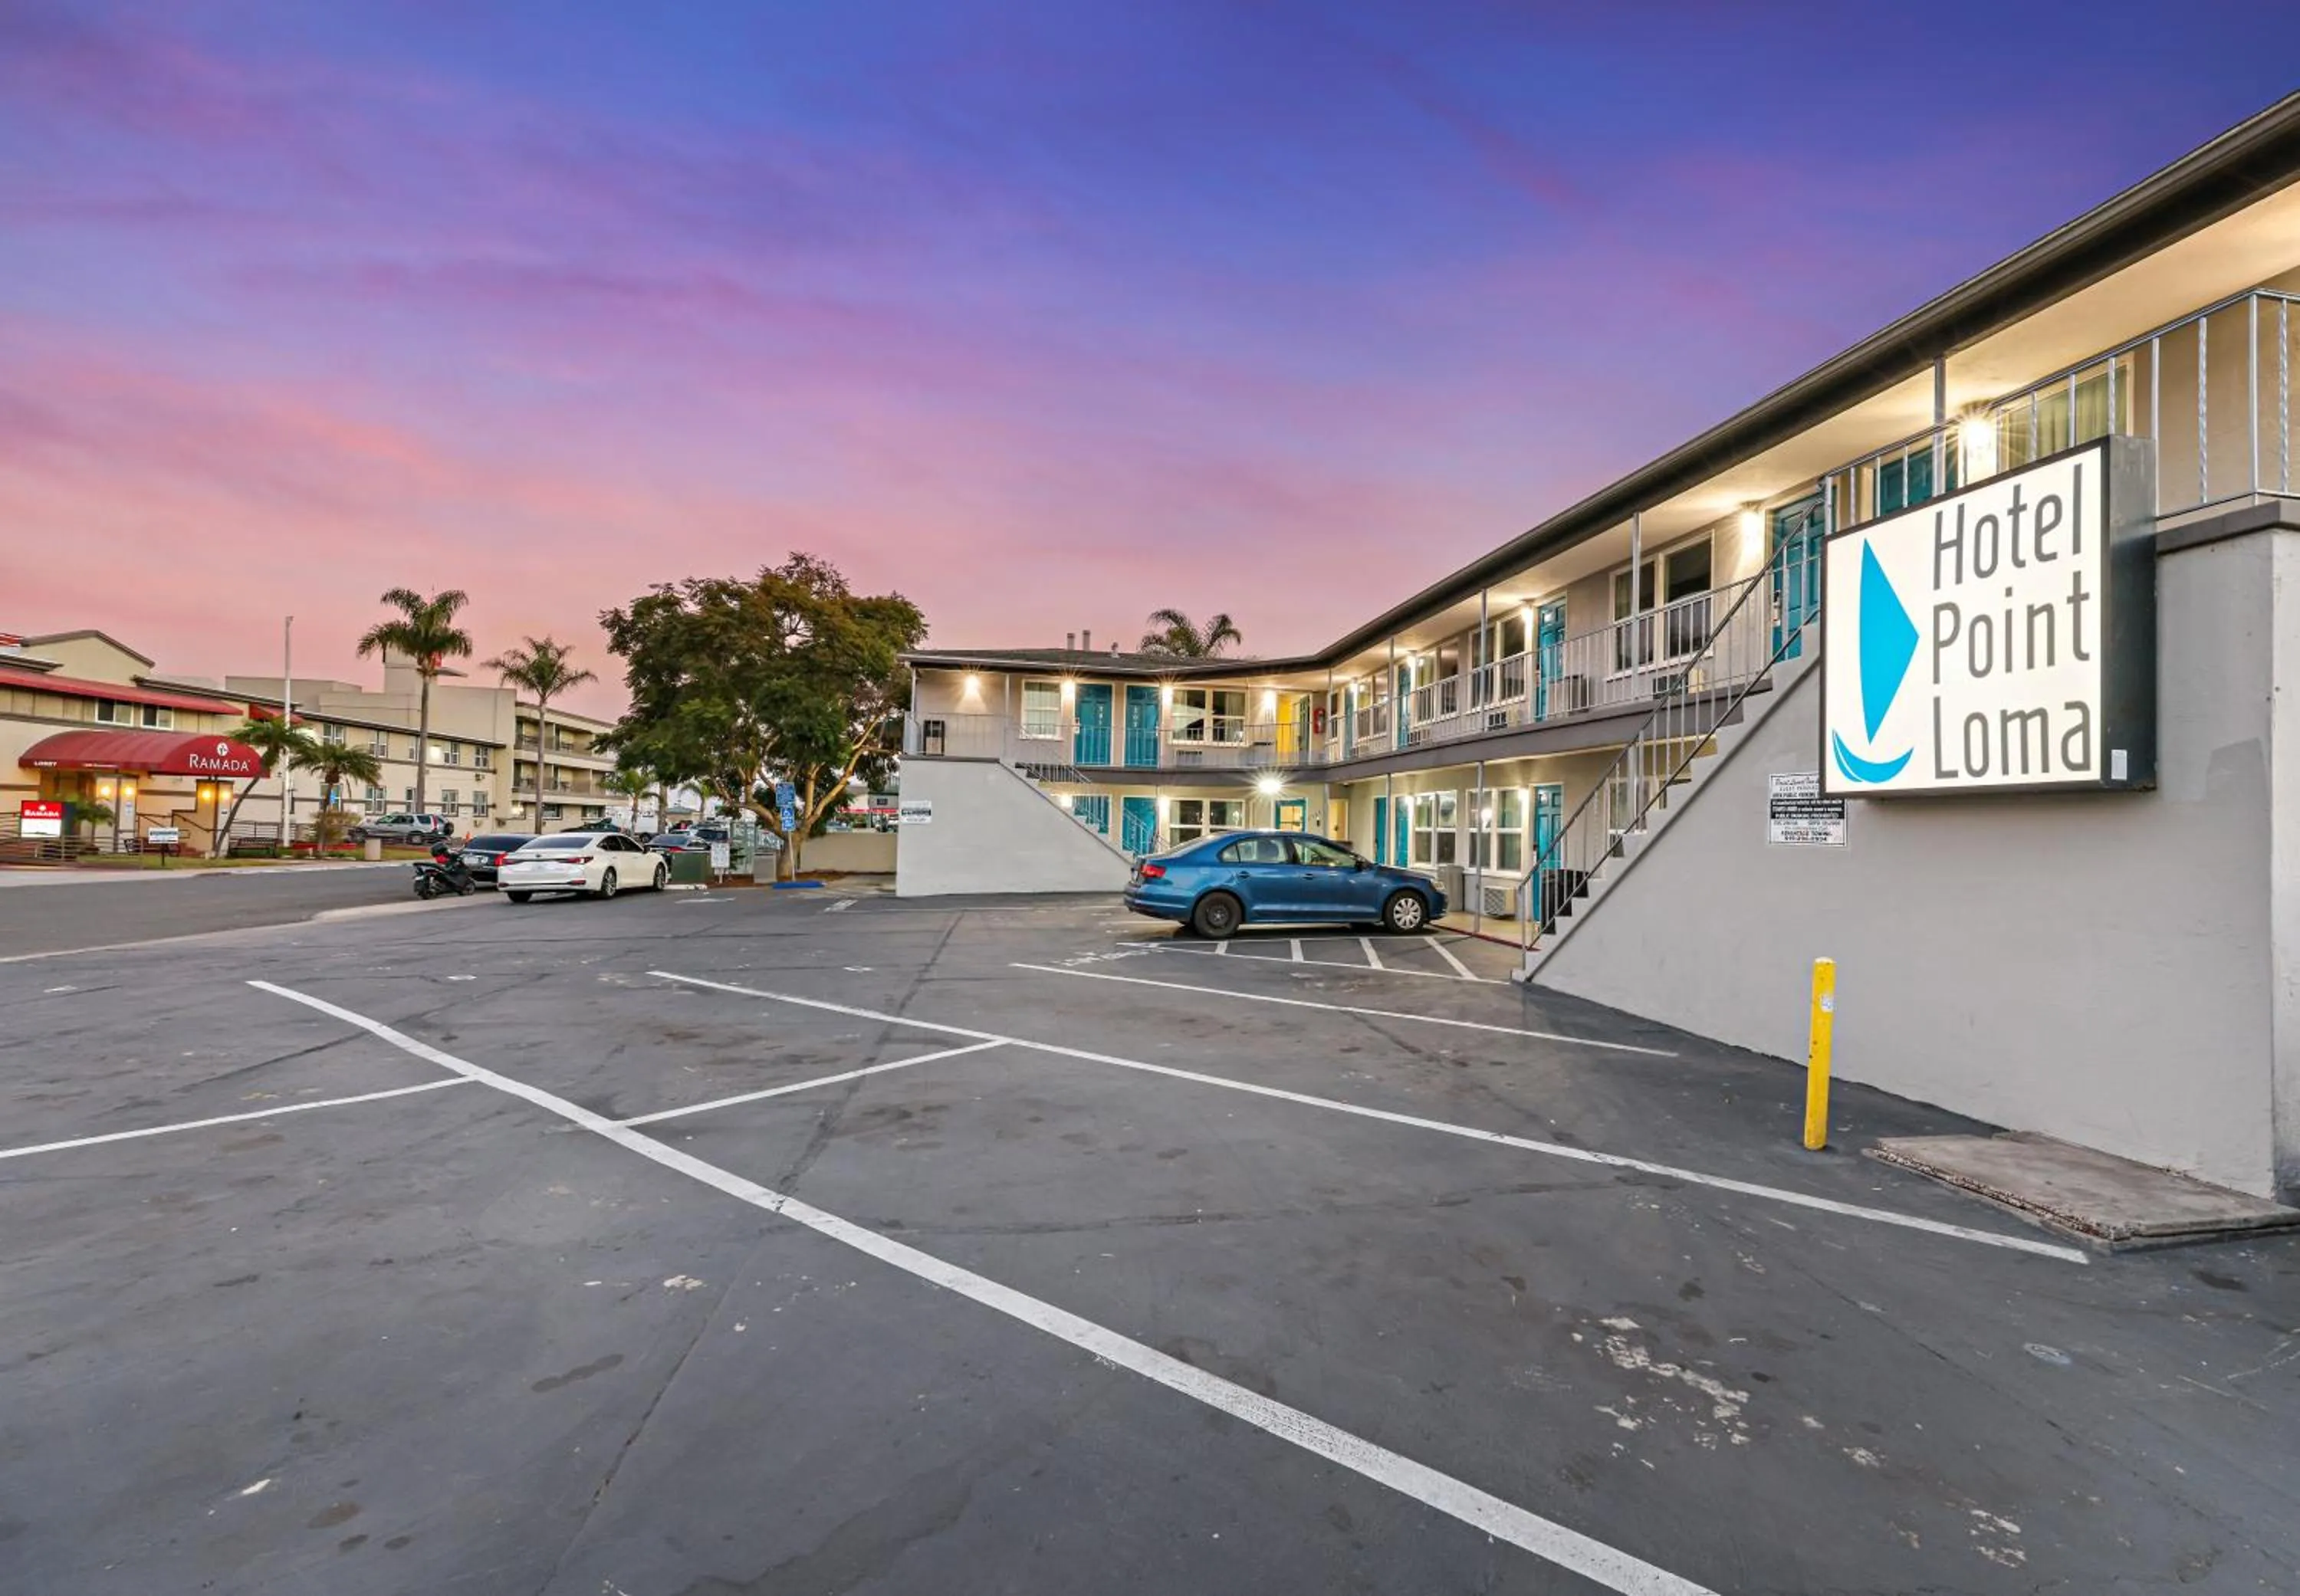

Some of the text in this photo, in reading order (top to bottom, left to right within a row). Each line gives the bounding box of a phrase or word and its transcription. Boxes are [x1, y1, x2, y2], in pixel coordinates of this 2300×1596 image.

[1933, 463, 2083, 591] Hotel
[1933, 570, 2091, 685] Point
[189, 754, 249, 772] RAMADA
[1934, 695, 2091, 780] Loma
